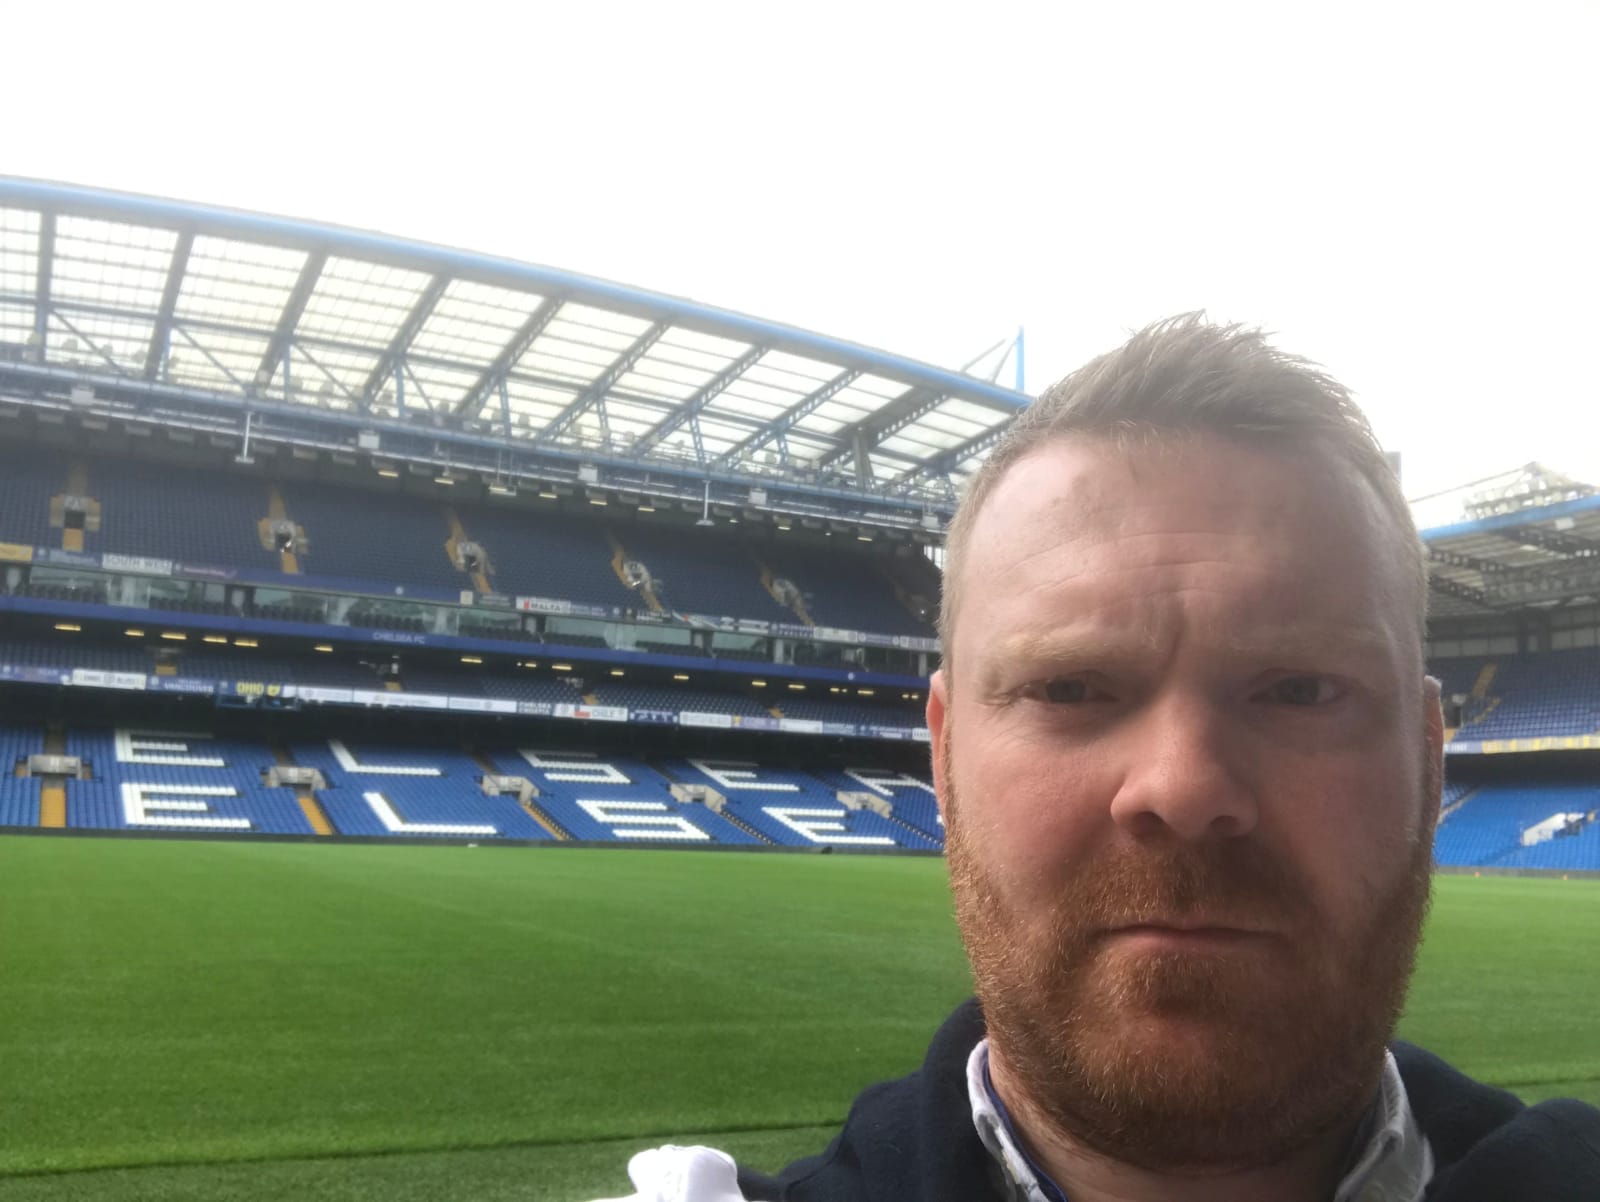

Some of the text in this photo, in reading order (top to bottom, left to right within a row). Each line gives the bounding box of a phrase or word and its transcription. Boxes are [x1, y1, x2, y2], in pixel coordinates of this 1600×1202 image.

[530, 602, 561, 612] MALTA
[372, 630, 426, 645] CHELSEA FC
[164, 682, 214, 693] VANCOUVER
[236, 680, 265, 696] OHIO
